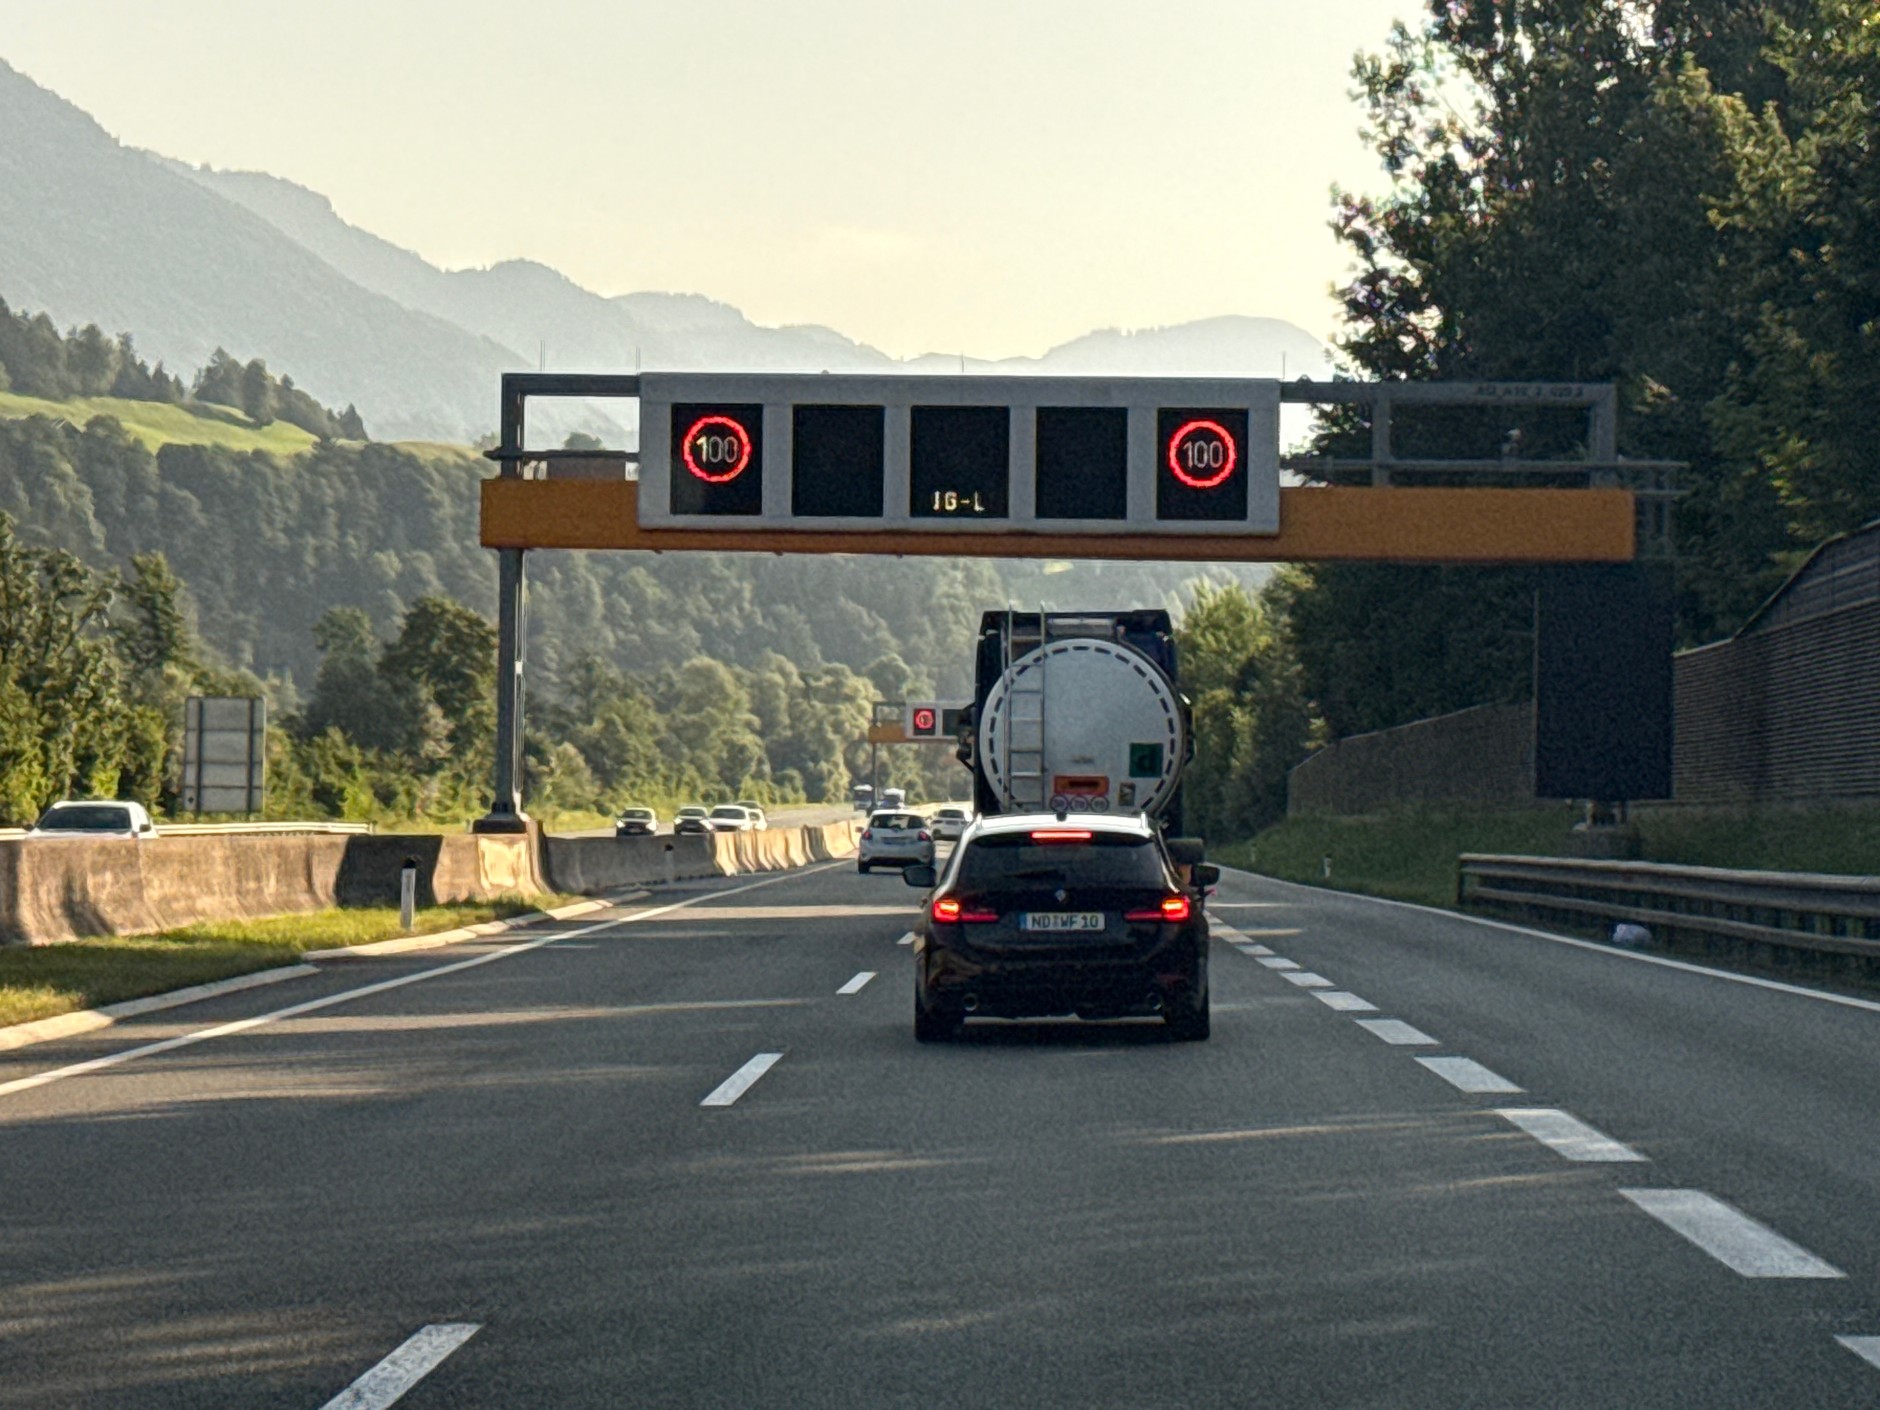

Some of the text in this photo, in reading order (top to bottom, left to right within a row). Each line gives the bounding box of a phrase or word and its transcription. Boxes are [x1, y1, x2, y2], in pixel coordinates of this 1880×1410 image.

[696, 436, 738, 463] 100
[1183, 441, 1223, 468] 100
[933, 491, 985, 511] IG-L
[1031, 915, 1051, 928] ND
[1081, 915, 1099, 928] 10
